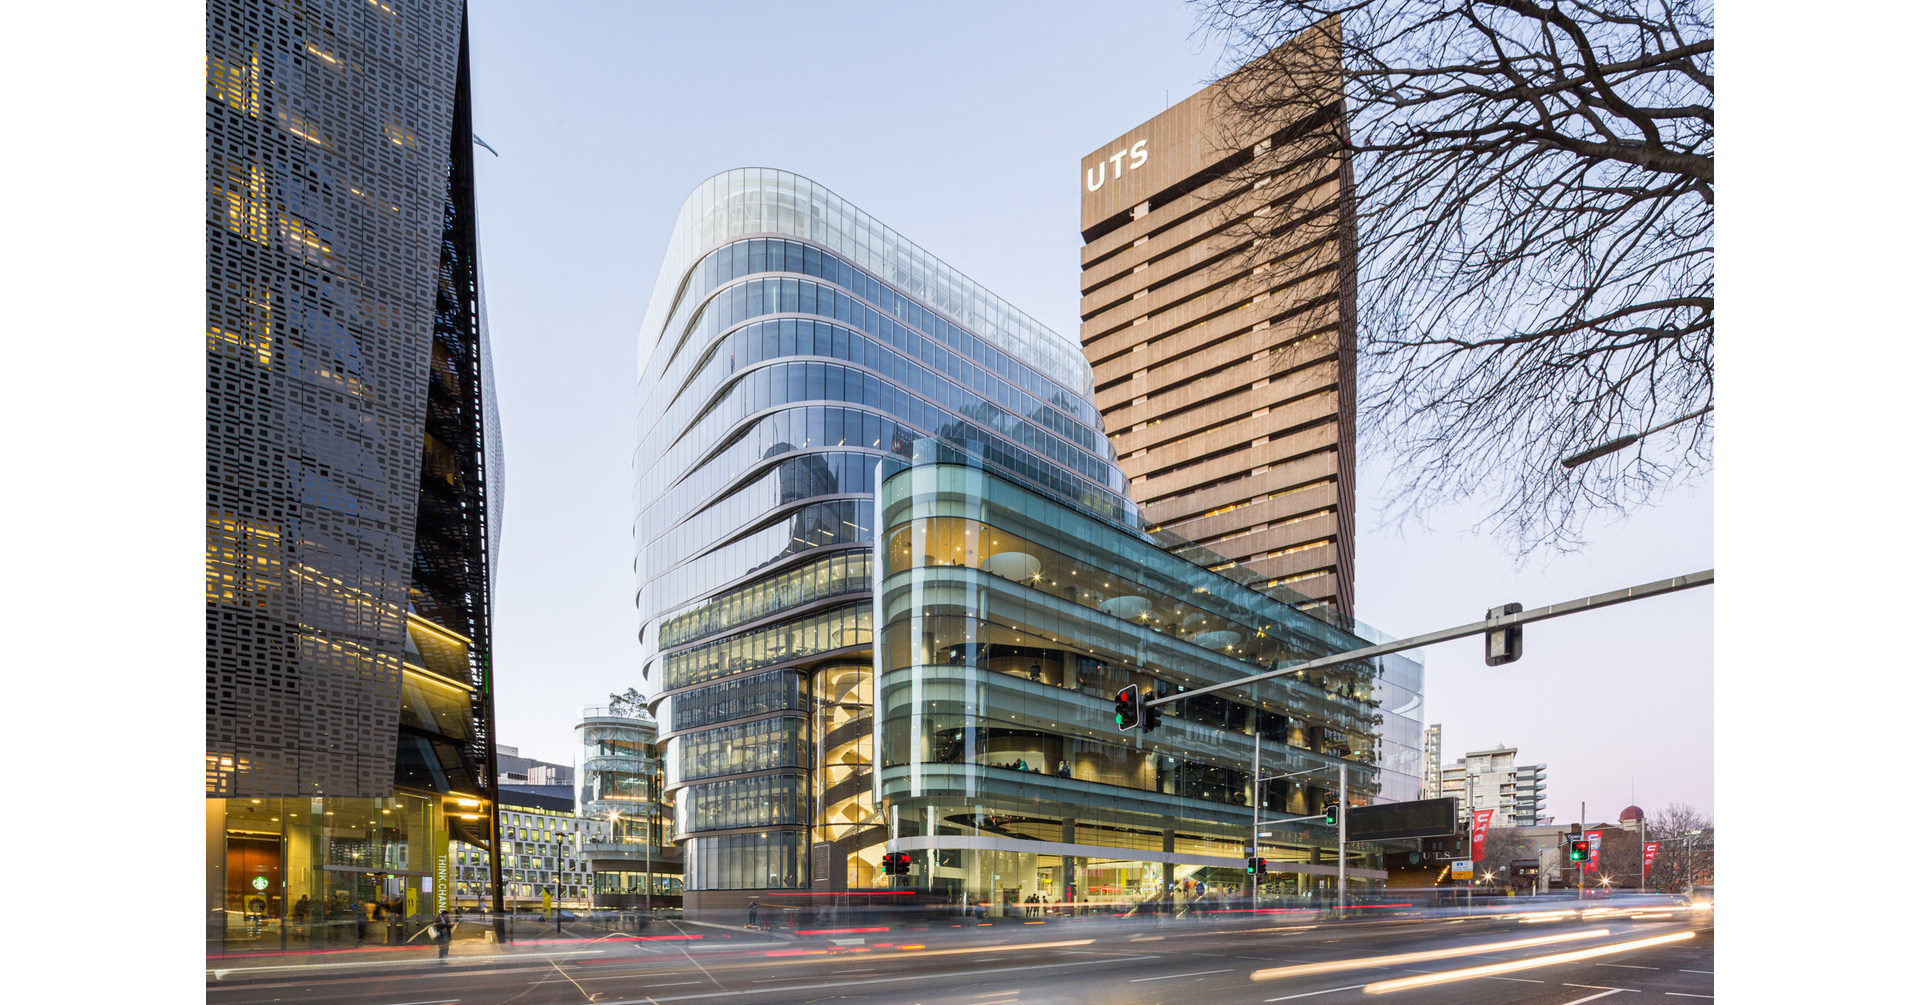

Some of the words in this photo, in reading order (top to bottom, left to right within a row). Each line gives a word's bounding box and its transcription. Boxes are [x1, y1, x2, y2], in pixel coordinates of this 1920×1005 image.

[1087, 139, 1148, 192] UTS
[1474, 813, 1489, 842] UTS
[1423, 852, 1450, 860] UTS
